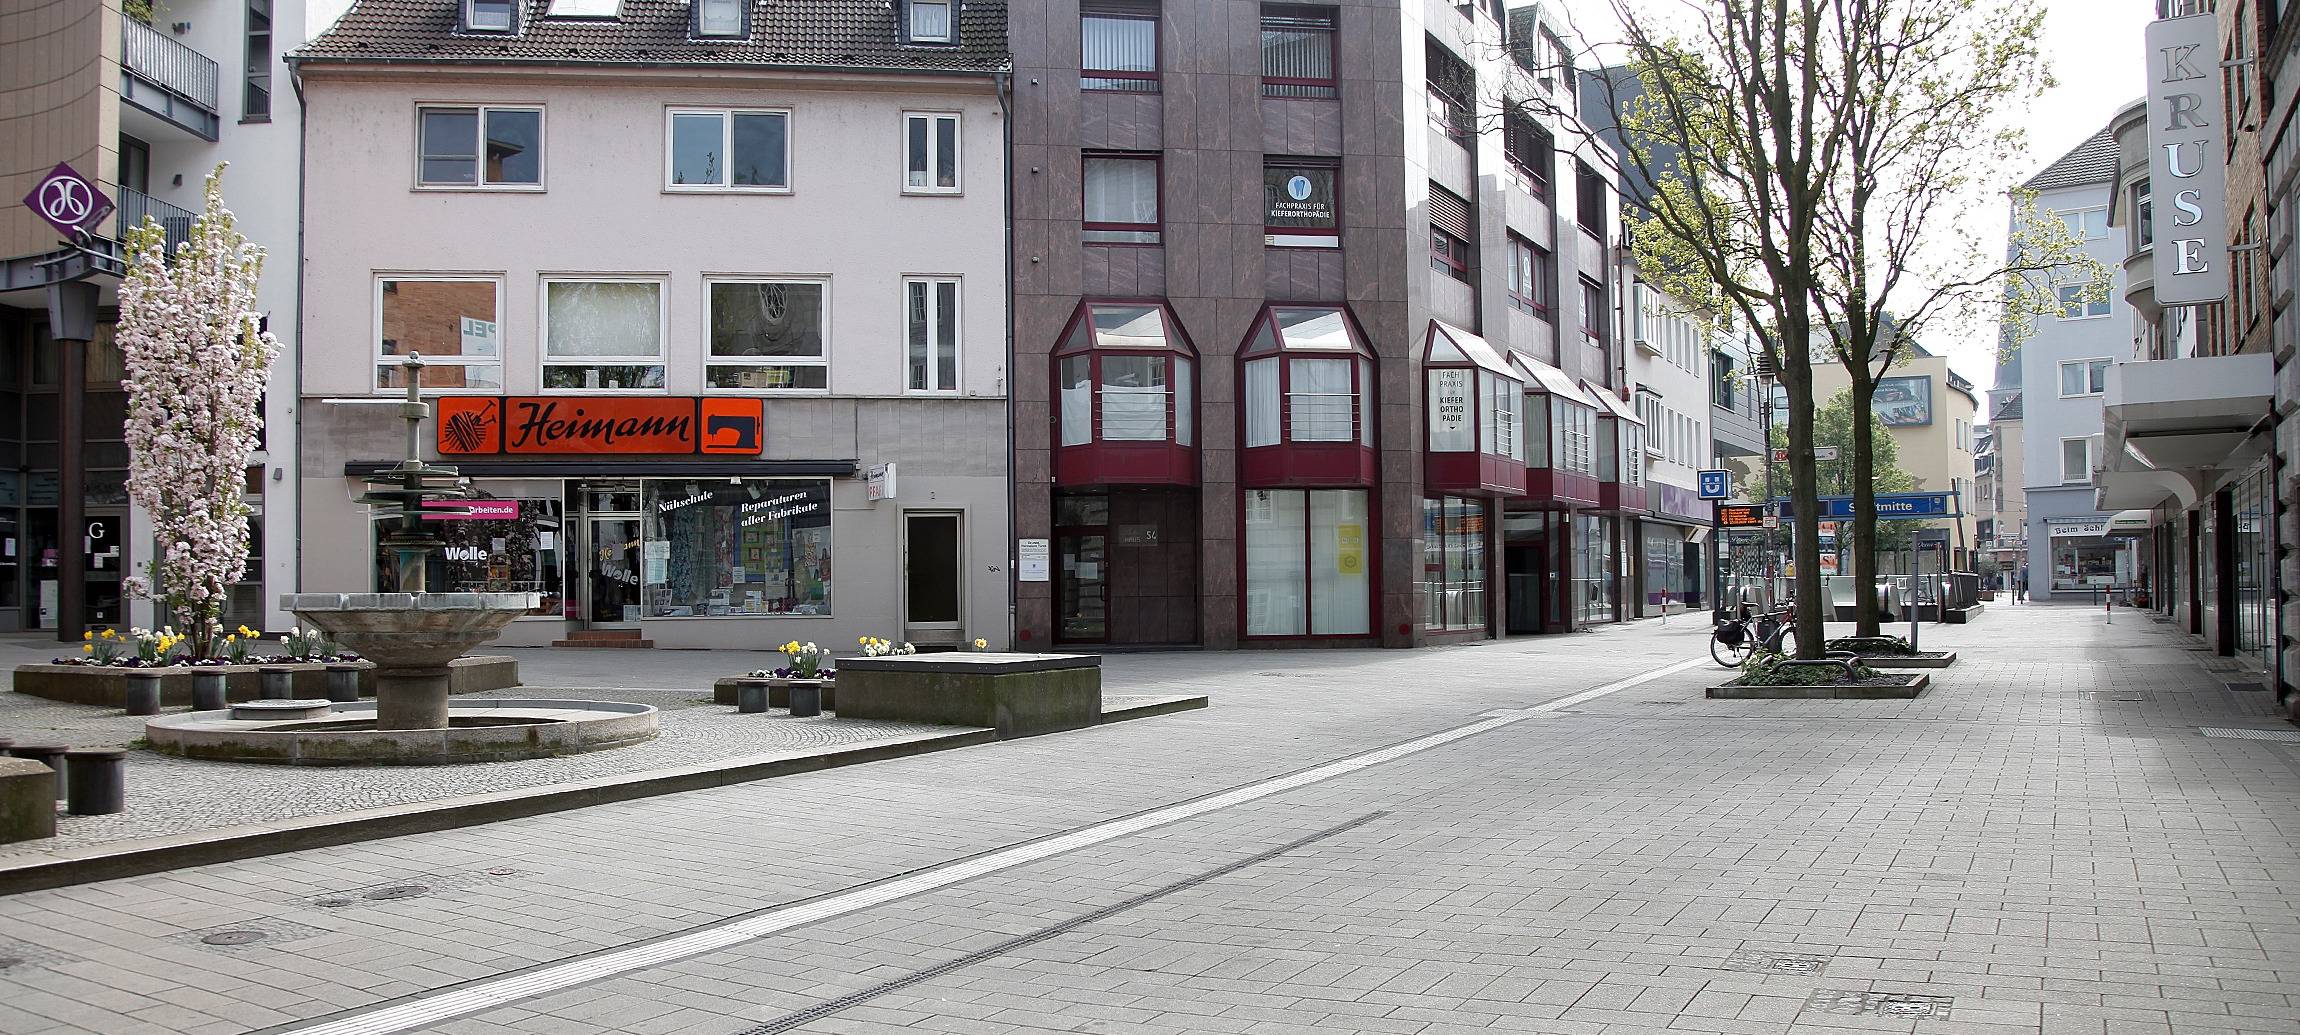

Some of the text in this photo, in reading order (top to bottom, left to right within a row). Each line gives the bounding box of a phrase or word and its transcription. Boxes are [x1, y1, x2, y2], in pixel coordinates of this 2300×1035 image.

[2159, 43, 2209, 277] KRUSE
[1275, 202, 1325, 210] FACHPRAXIS FÜR
[1271, 210, 1330, 218] KIEFERORTHOPÄDIE
[1442, 371, 1460, 379] FACH
[1439, 380, 1463, 388] PRAXIS
[1439, 396, 1464, 404] KIEFER
[1440, 405, 1464, 413] ORTHO
[1442, 413, 1462, 422] PÄDIE
[511, 401, 690, 448] Heimann
[658, 490, 714, 513] Nähschule
[741, 491, 807, 513] Reparaturen
[470, 506, 513, 514] arbeiten.de
[1848, 501, 1913, 513] Stmitte
[741, 502, 819, 529] aller Fabrikate
[88, 522, 104, 539] G
[1146, 530, 1157, 540] 54
[2055, 527, 2078, 535] Beim
[444, 546, 488, 562] Wolle
[601, 560, 639, 585] Wolle
